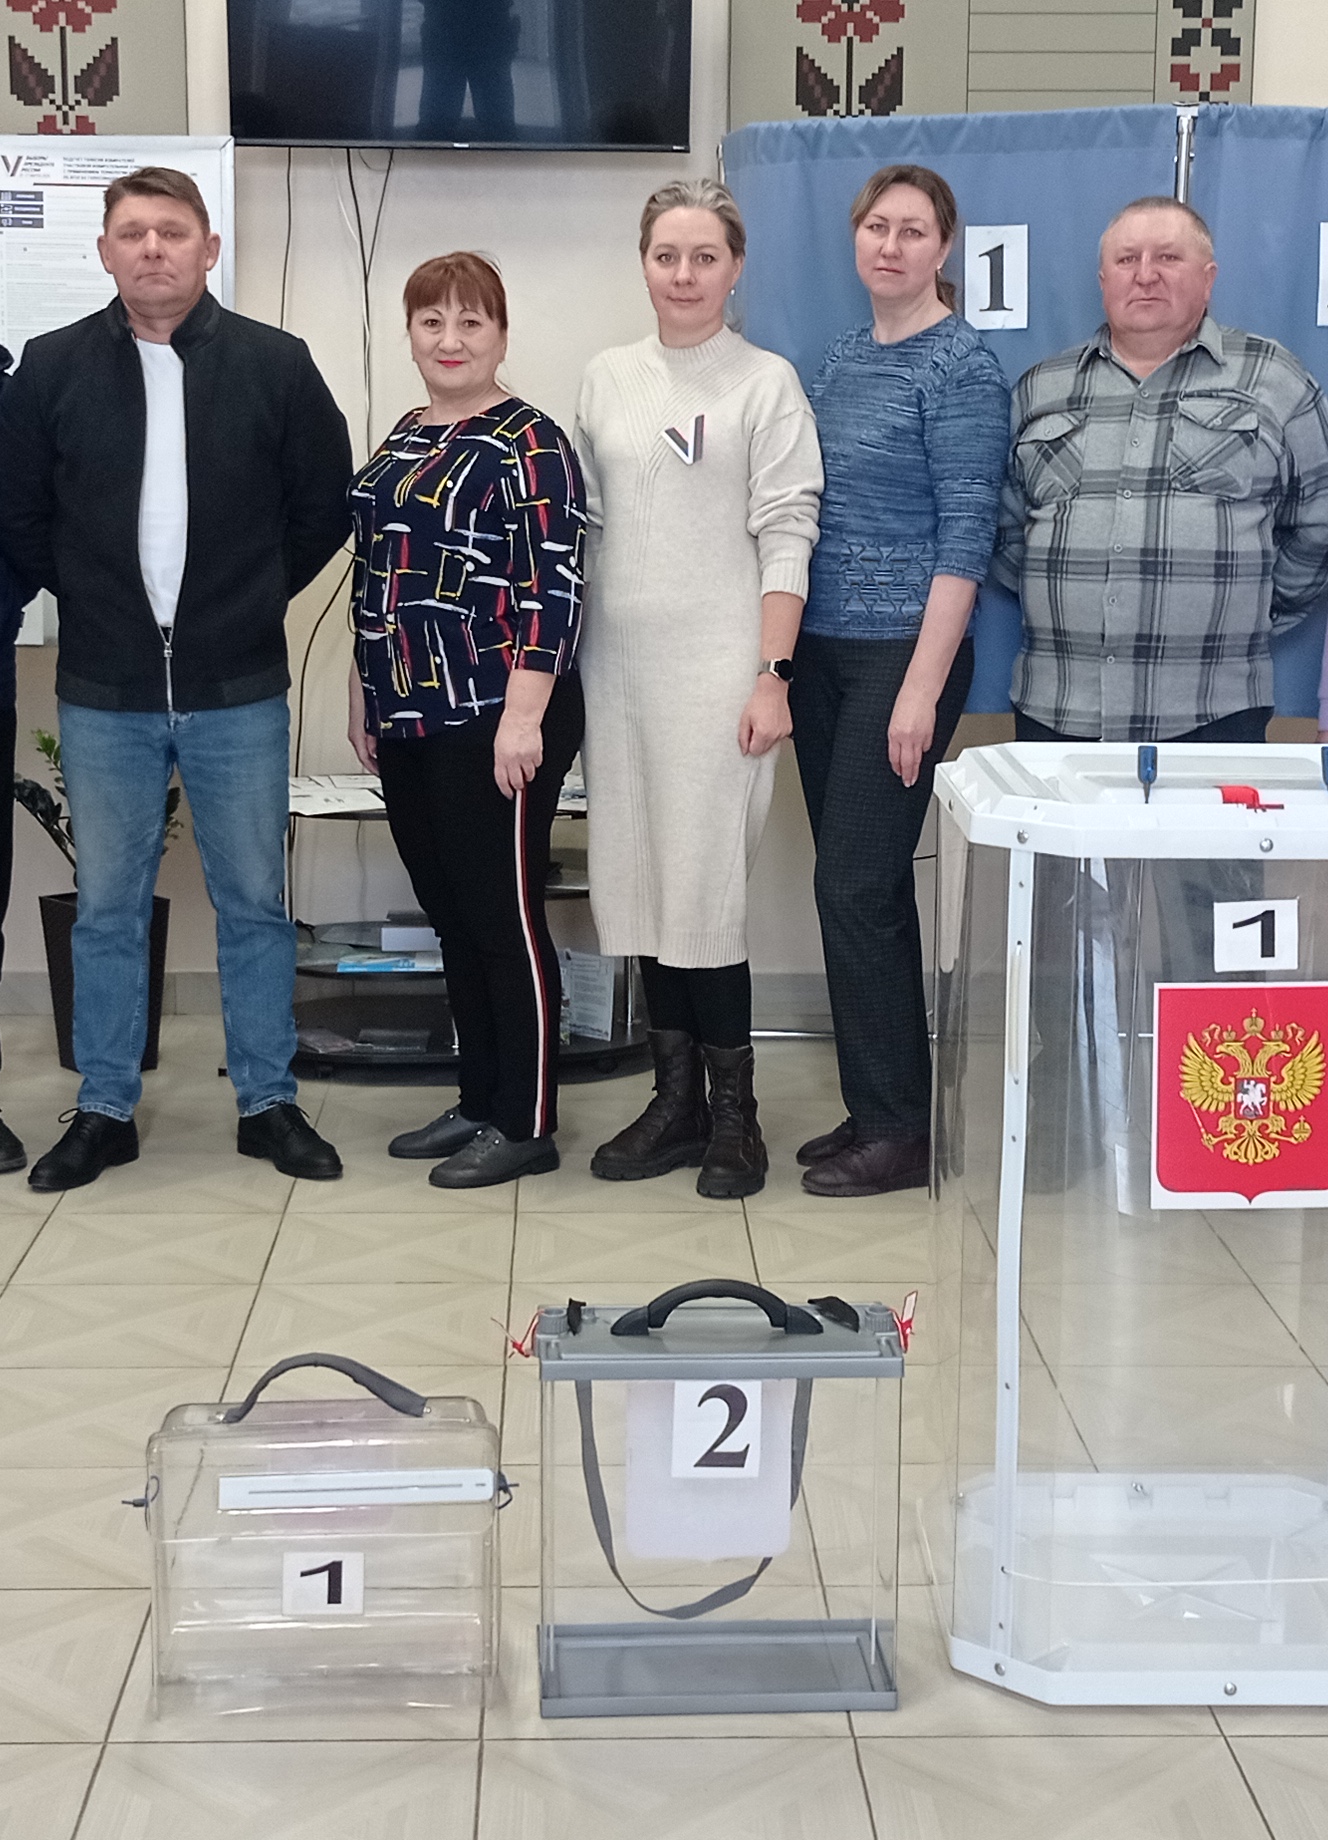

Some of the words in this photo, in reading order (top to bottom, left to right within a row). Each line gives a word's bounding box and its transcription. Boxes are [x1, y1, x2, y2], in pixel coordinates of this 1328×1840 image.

[978, 243, 1013, 312] 1
[1232, 909, 1276, 958] 1
[693, 1383, 751, 1469] 2
[300, 1560, 343, 1605] 1
